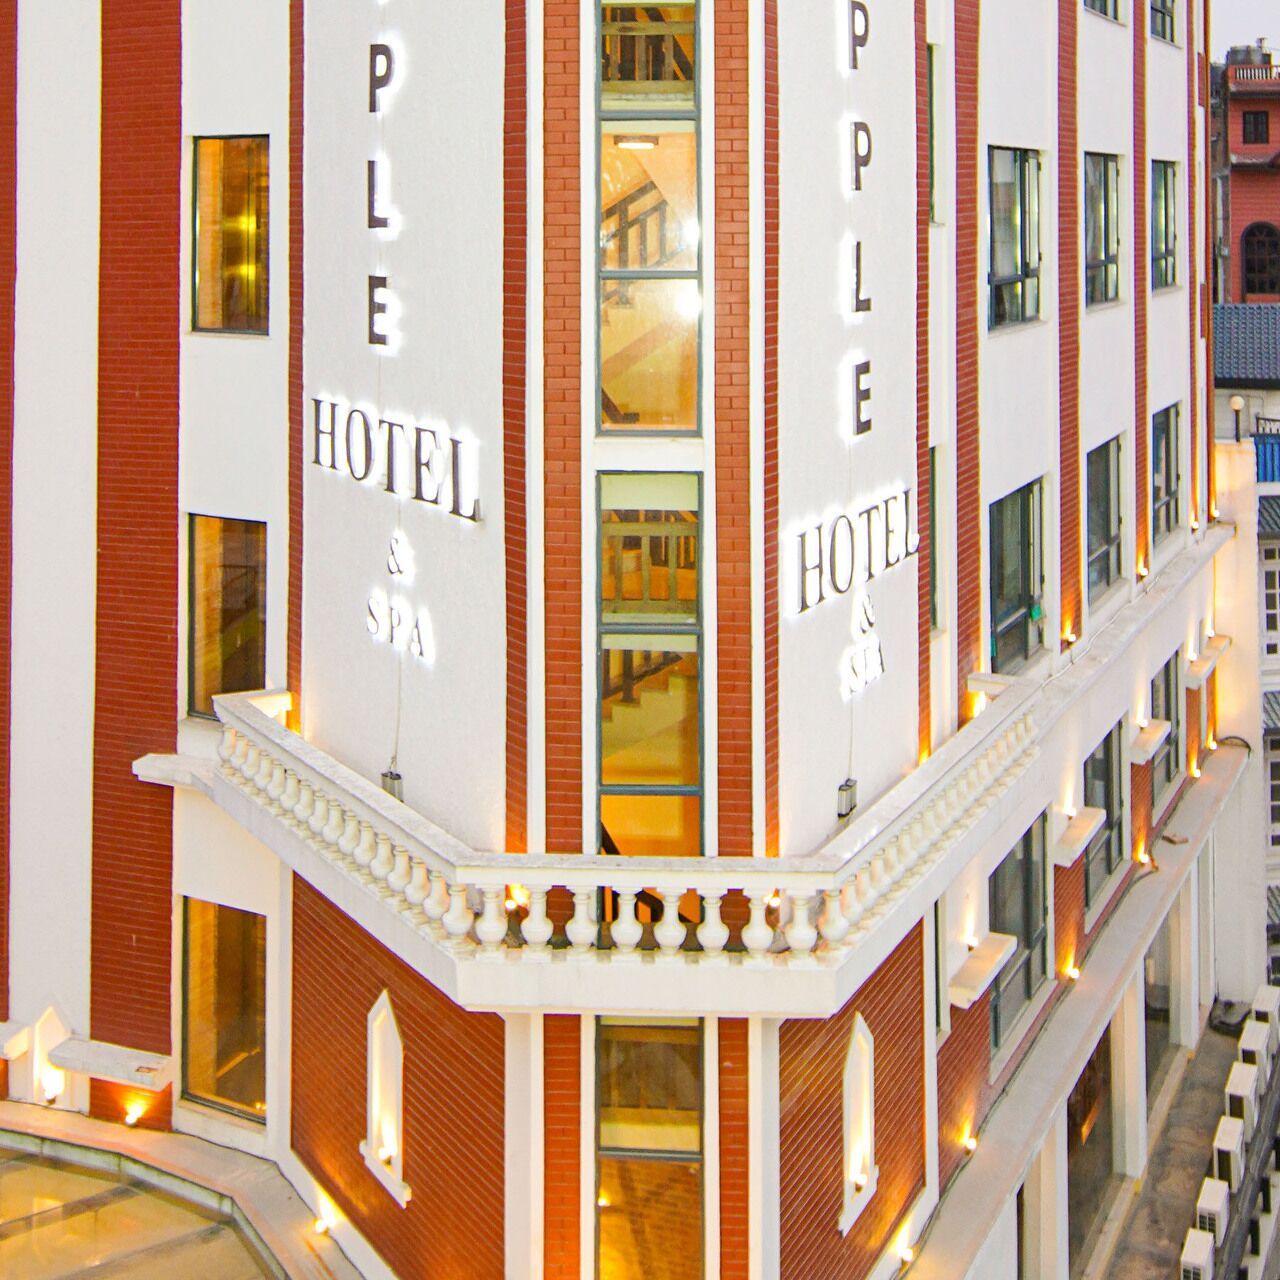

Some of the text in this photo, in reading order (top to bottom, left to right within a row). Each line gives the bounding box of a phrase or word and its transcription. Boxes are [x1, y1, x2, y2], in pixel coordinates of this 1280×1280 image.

[311, 398, 481, 522] HOTEL
[387, 537, 404, 575] &
[797, 488, 919, 614] HOTEL
[367, 596, 425, 657] SPA
